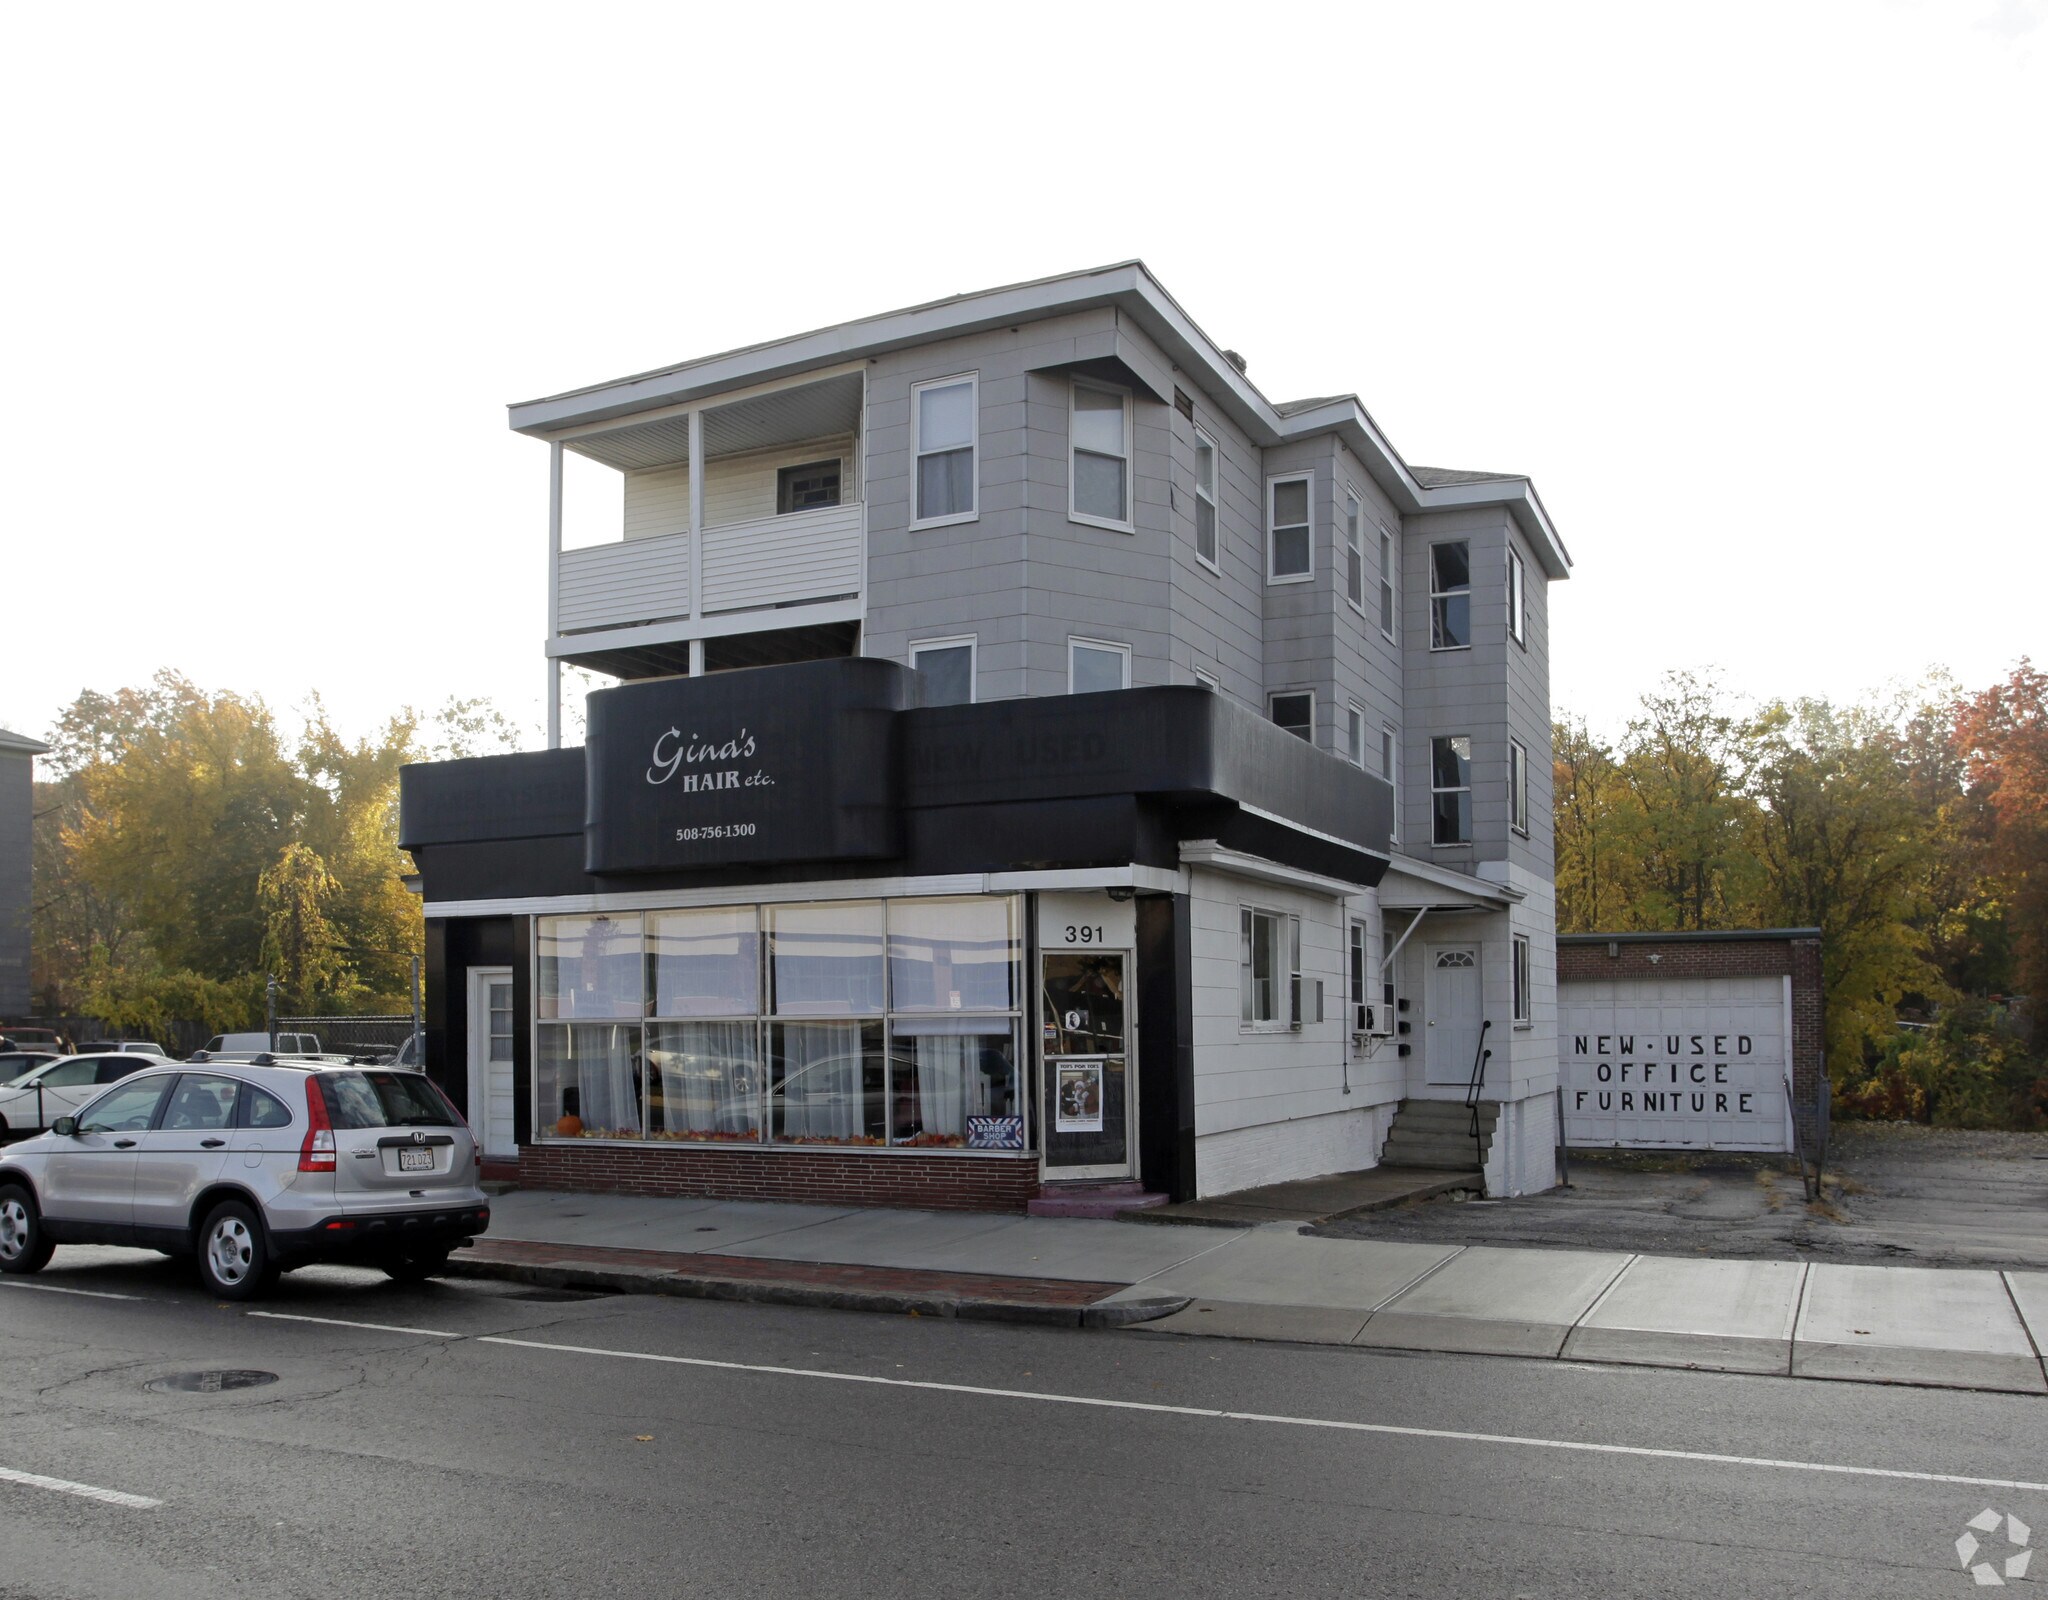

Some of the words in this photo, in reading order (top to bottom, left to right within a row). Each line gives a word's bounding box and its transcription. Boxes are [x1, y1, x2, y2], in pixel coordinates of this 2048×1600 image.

[646, 726, 756, 785] Gina's
[683, 770, 741, 793] HAIR
[744, 769, 776, 787] etc.
[675, 823, 757, 842] 508-756-1300
[1064, 925, 1104, 943] 391
[1575, 1035, 1634, 1055] NEW
[1667, 1035, 1753, 1055] USED
[1597, 1063, 1728, 1083] OFFICE
[1576, 1091, 1753, 1113] FURNITURE
[977, 1125, 1012, 1133] BARBER
[983, 1132, 1007, 1140] SHOP
[402, 1154, 417, 1166] 721
